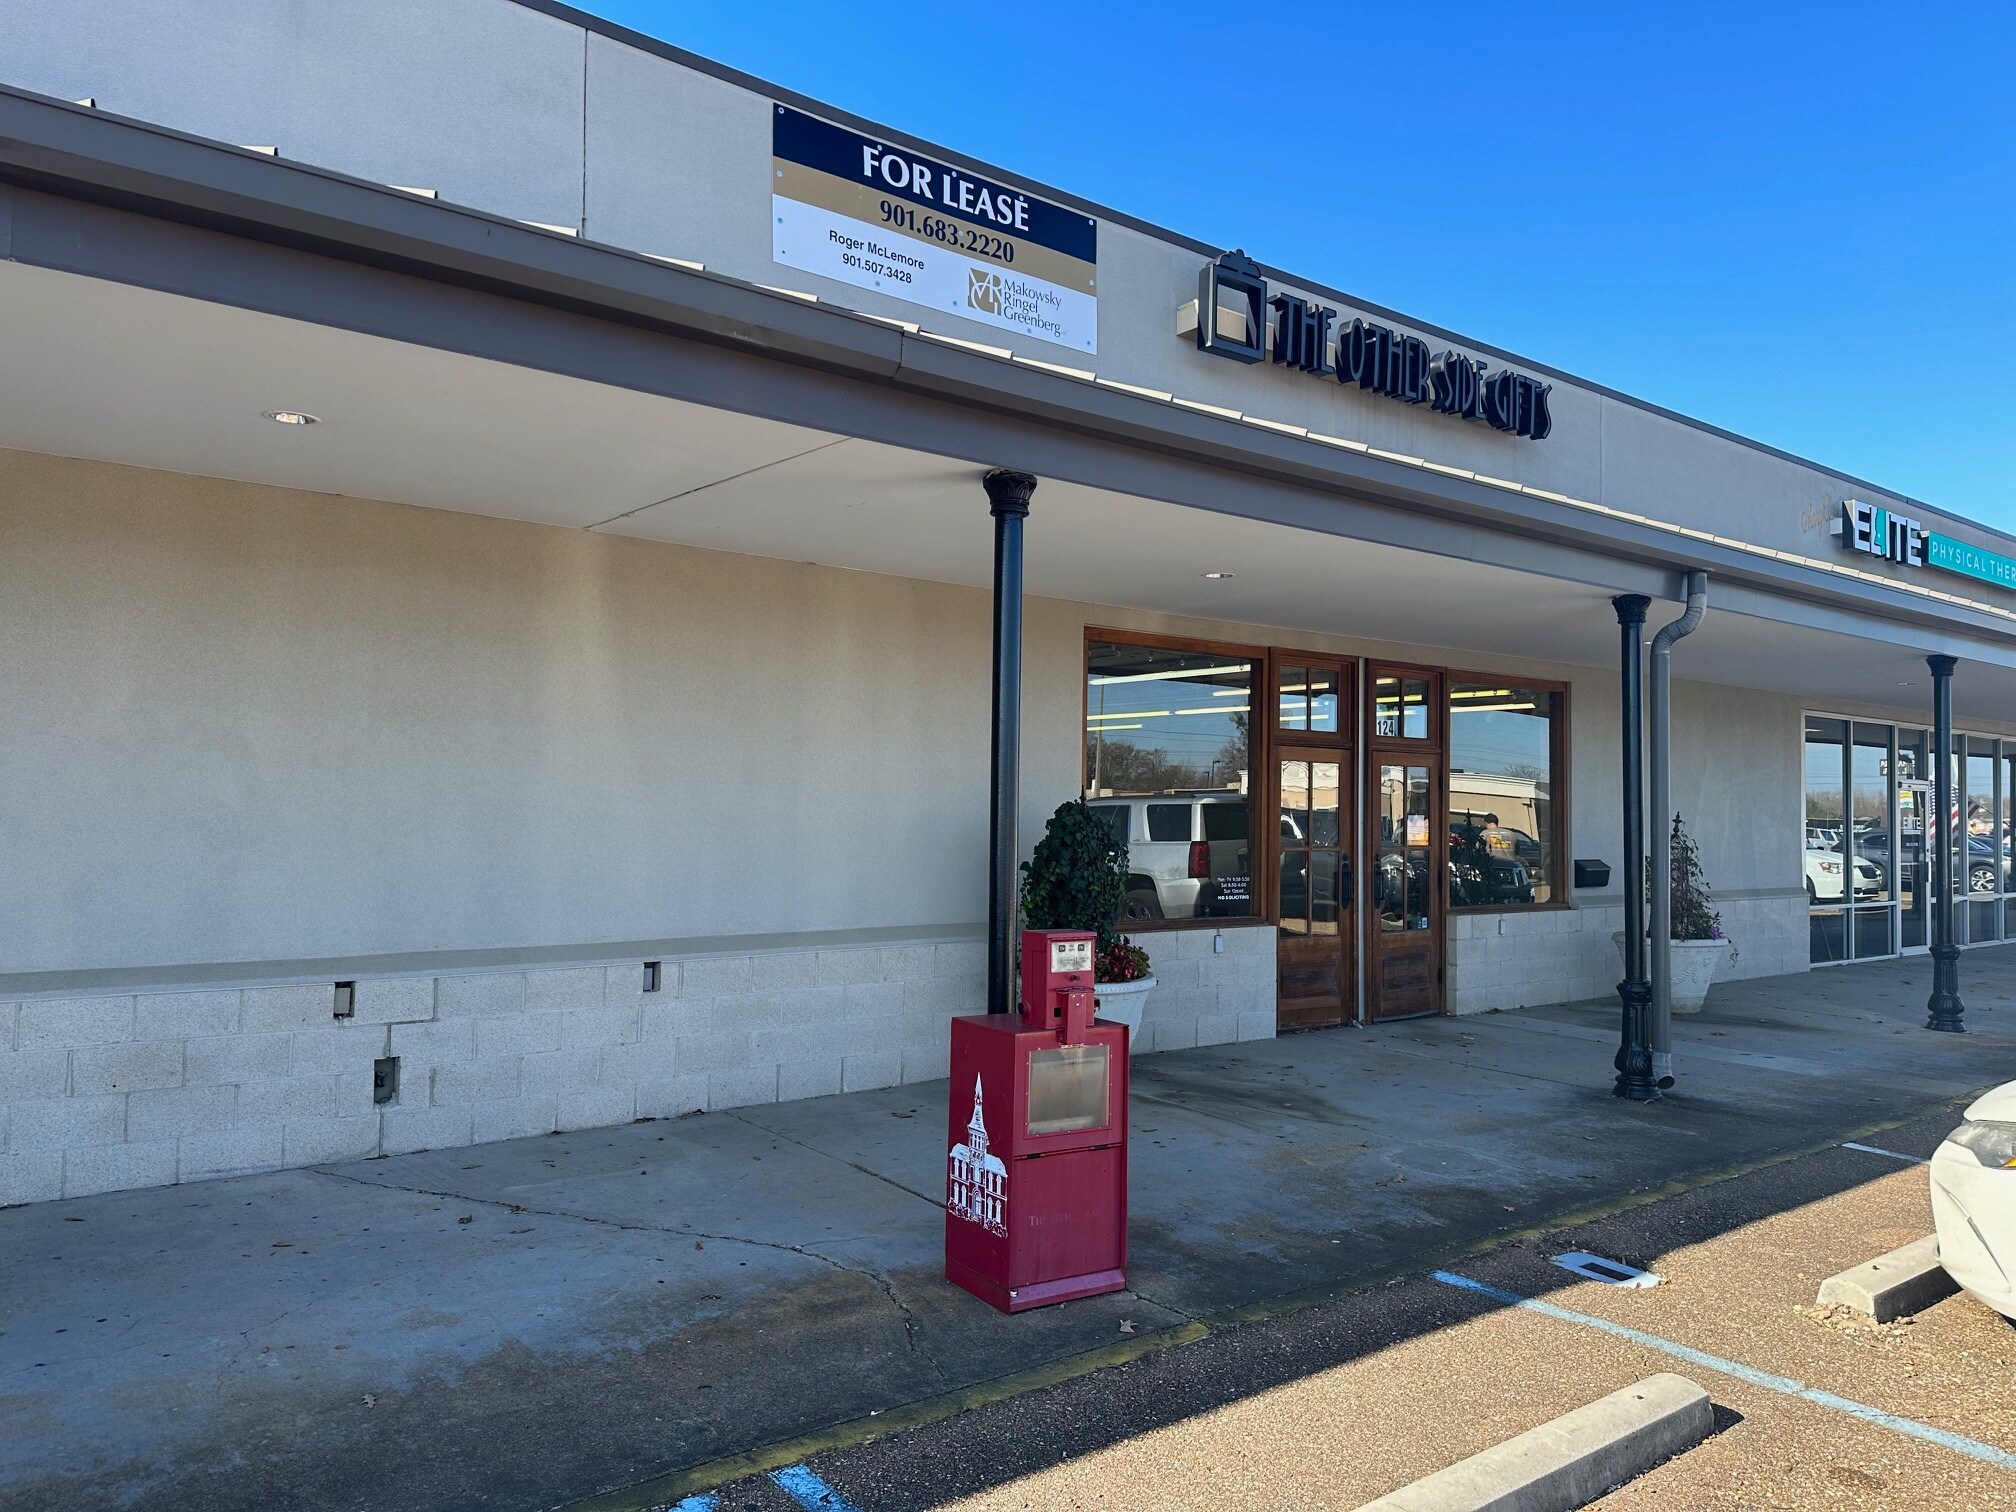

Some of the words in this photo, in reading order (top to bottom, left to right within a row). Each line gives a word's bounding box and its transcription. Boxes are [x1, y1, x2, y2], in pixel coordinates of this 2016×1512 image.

[863, 145, 933, 199] FOR
[943, 173, 1029, 231] LEASE
[880, 200, 1015, 263] 901.683.2220
[829, 230, 864, 250] Roger
[867, 241, 925, 270] McLemore
[842, 253, 912, 284] 901.507.3428
[1004, 278, 1062, 311] Makowsky
[1004, 291, 1038, 315] Ringel
[1004, 306, 1061, 338] Greenberg
[1269, 291, 1337, 376] THE
[1339, 317, 1431, 404] OTHER
[1434, 350, 1488, 419] SIDE
[1485, 369, 1552, 440] GIFTS
[1851, 499, 1922, 567] ELITE
[1932, 541, 1986, 573] PHYSICAL
[1377, 720, 1394, 736] 124
